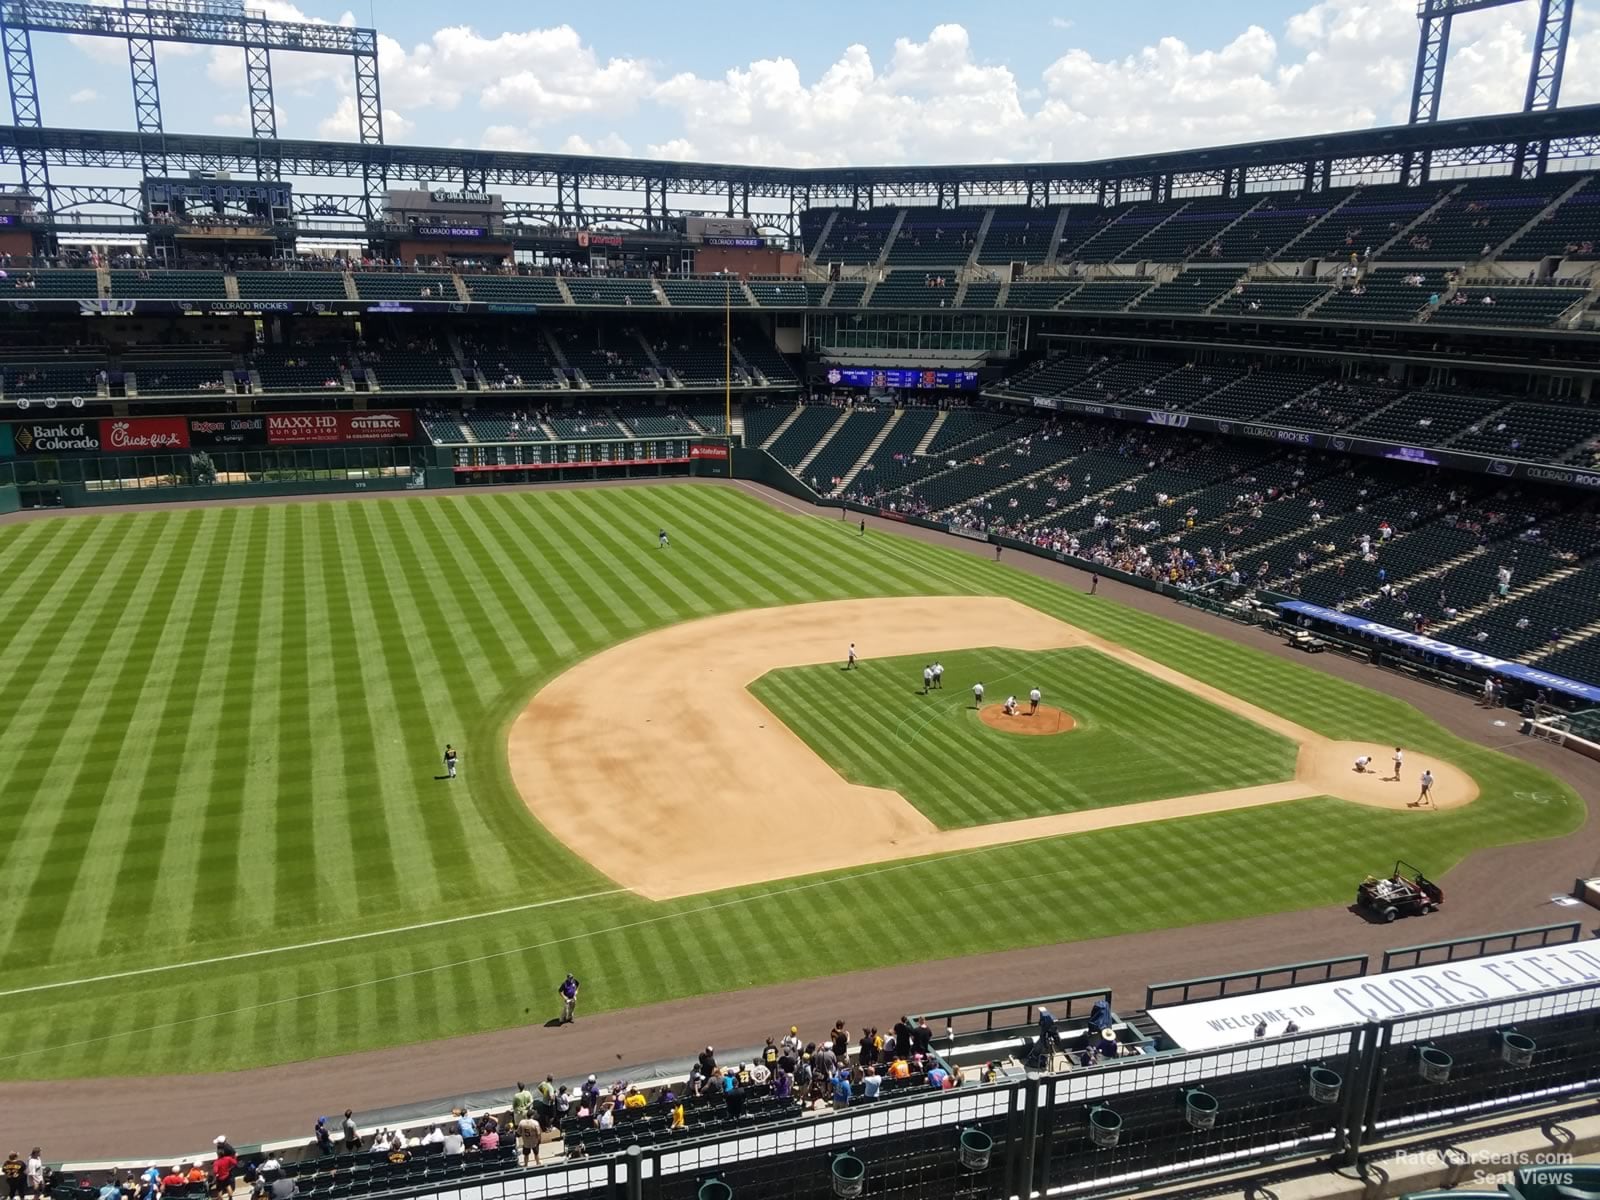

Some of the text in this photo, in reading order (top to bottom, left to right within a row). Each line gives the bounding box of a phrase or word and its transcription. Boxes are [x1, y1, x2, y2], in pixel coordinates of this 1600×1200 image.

[447, 191, 464, 200] JACK
[419, 227, 450, 235] COLORADO
[211, 302, 251, 310] COLORADO
[191, 419, 263, 433] Exxon Mobil
[269, 416, 337, 428] MAXX HD
[351, 419, 401, 428] OUTBACK
[33, 423, 86, 438] Bank of
[111, 422, 181, 447] Chick-fil-A
[269, 428, 337, 436] sunglasses
[1243, 425, 1310, 443] COLORADO ROCKIES
[35, 436, 99, 450] Colorado
[1527, 467, 1573, 482] COLORADO
[1206, 1009, 1290, 1032] WELCOME
[1290, 1005, 1316, 1018] TO
[1333, 970, 1489, 1018] COORS
